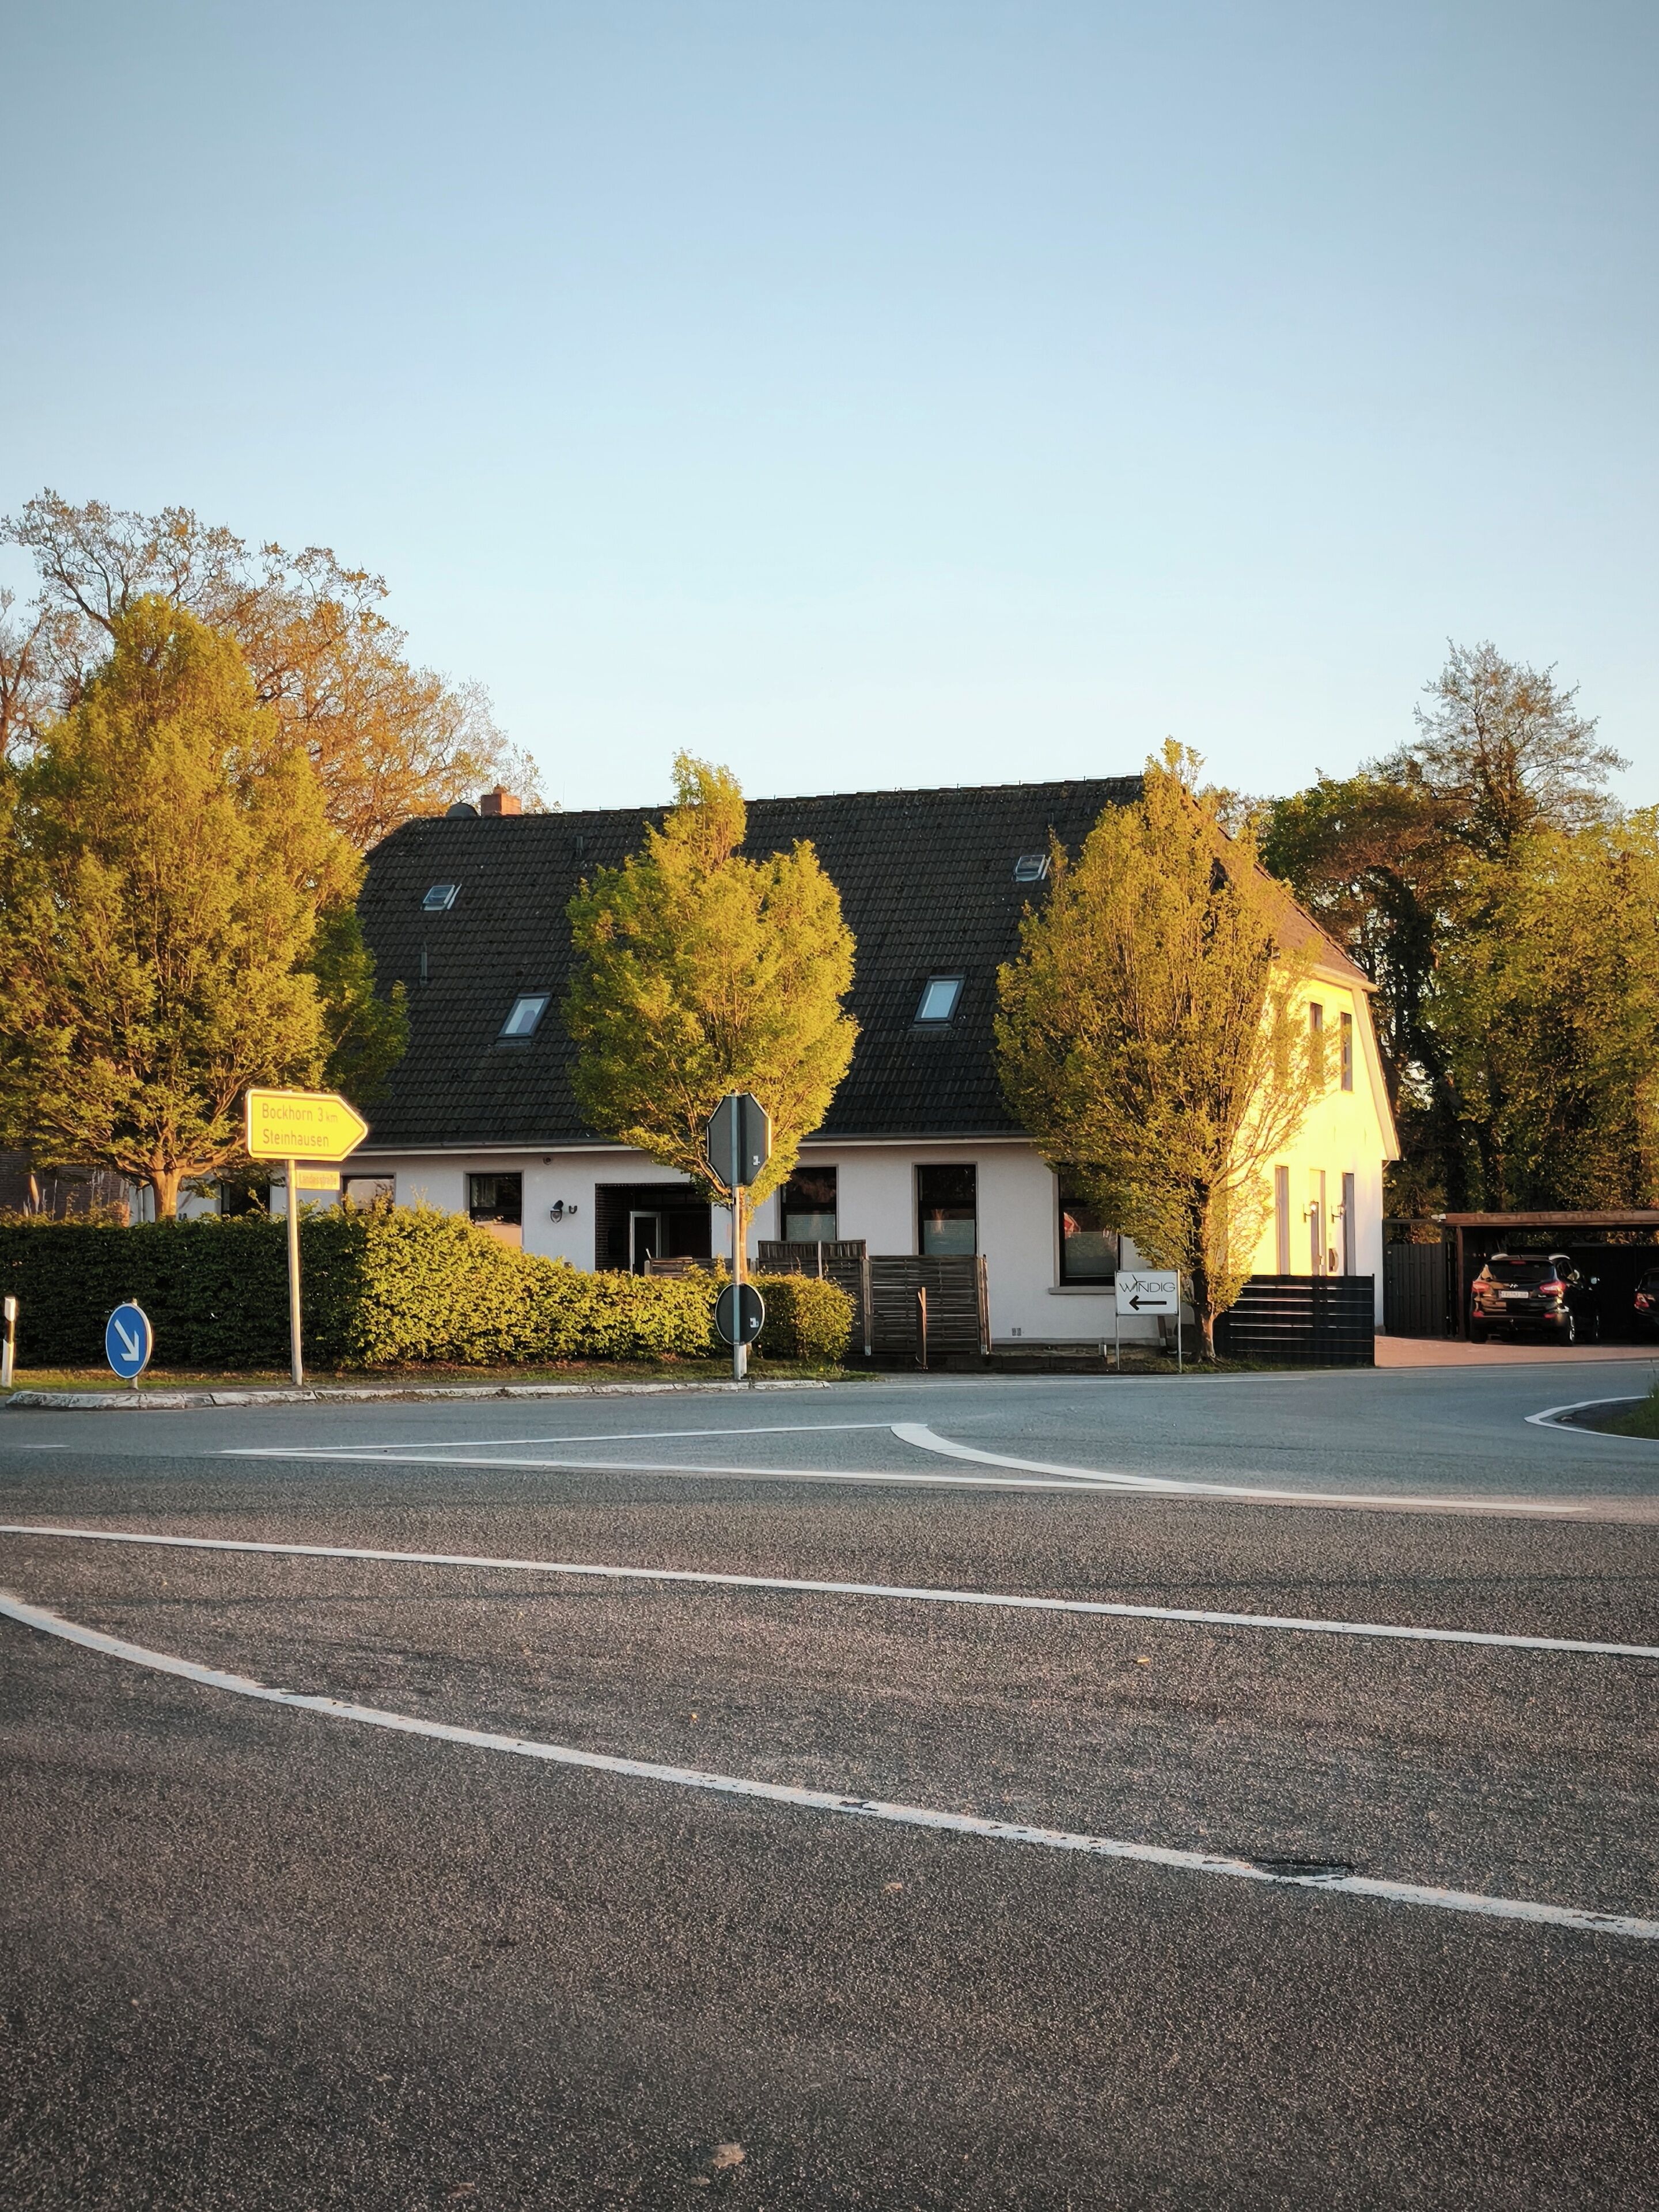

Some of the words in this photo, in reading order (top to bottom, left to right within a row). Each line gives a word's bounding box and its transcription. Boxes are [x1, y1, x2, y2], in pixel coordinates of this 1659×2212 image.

[262, 1103, 313, 1121] Bockhorn
[317, 1107, 324, 1122] 3
[325, 1111, 338, 1123] km
[263, 1128, 329, 1147] Steinhausen
